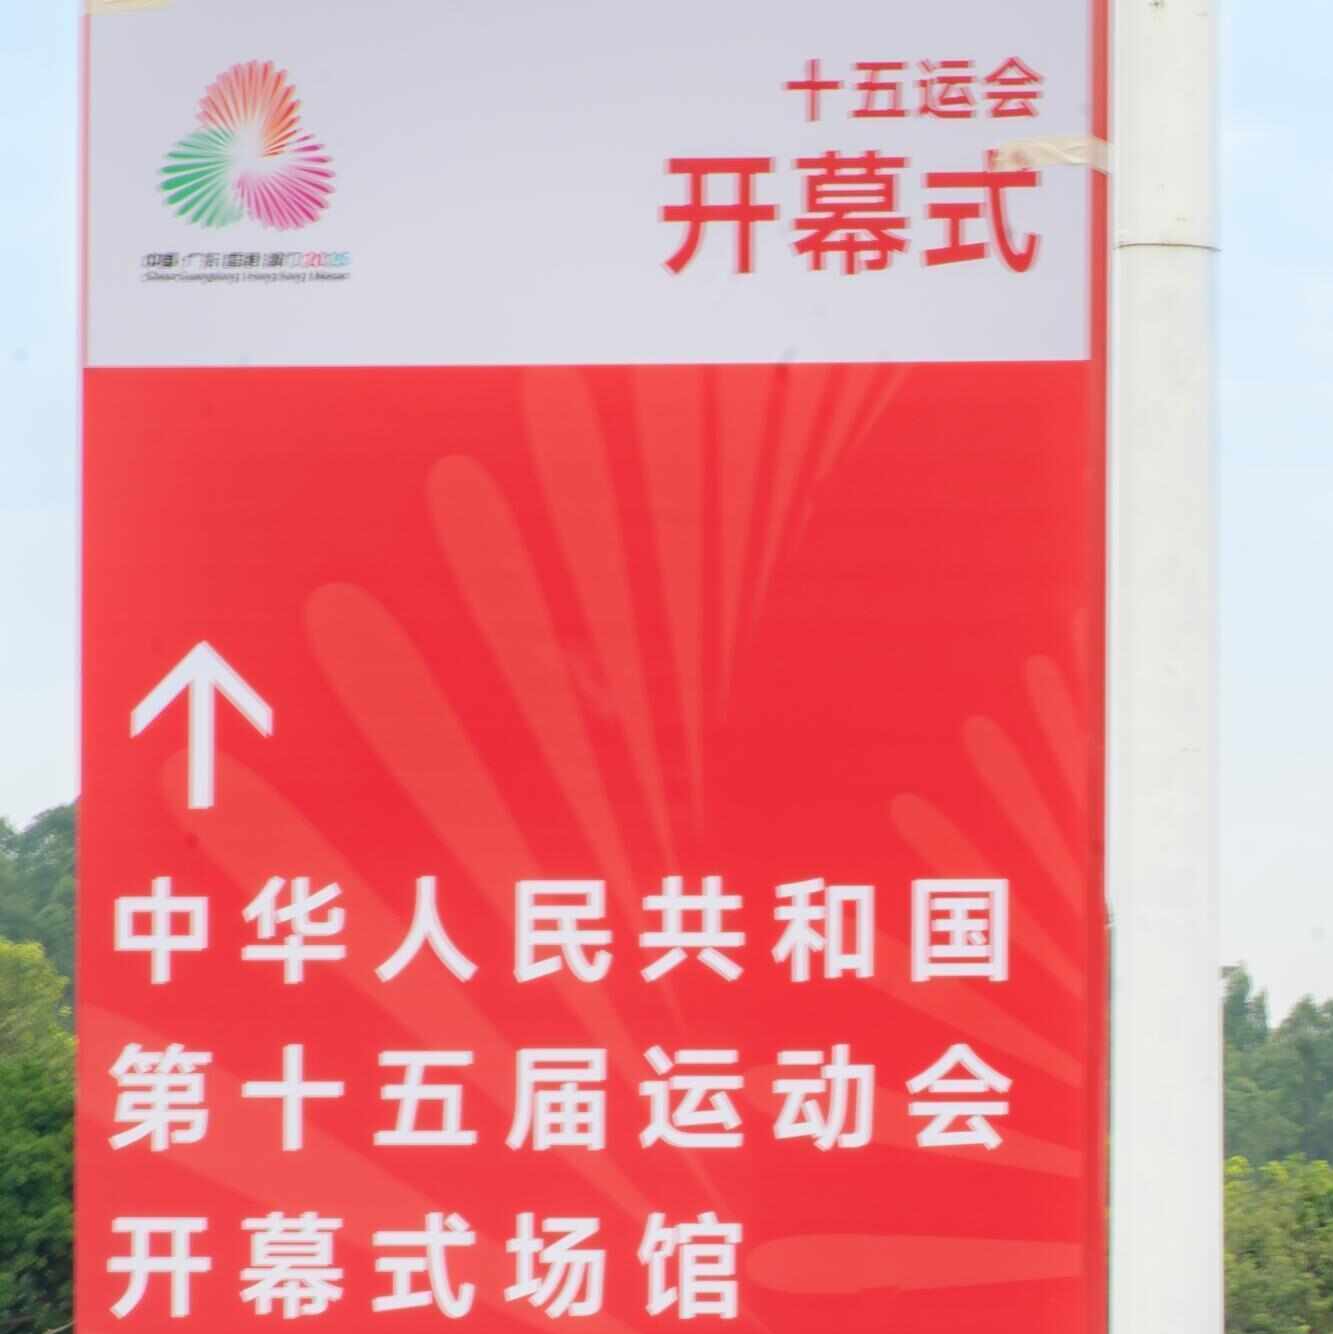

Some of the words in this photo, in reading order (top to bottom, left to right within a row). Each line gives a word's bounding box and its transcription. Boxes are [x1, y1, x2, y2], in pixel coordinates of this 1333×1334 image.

[785, 57, 1044, 120] 十五运会
[661, 149, 1039, 276] 开幕式
[113, 875, 1010, 985] 中华人民共和国
[107, 1042, 1011, 1153] 第十五届运动会
[105, 1211, 744, 1320] 开幕式场馆
